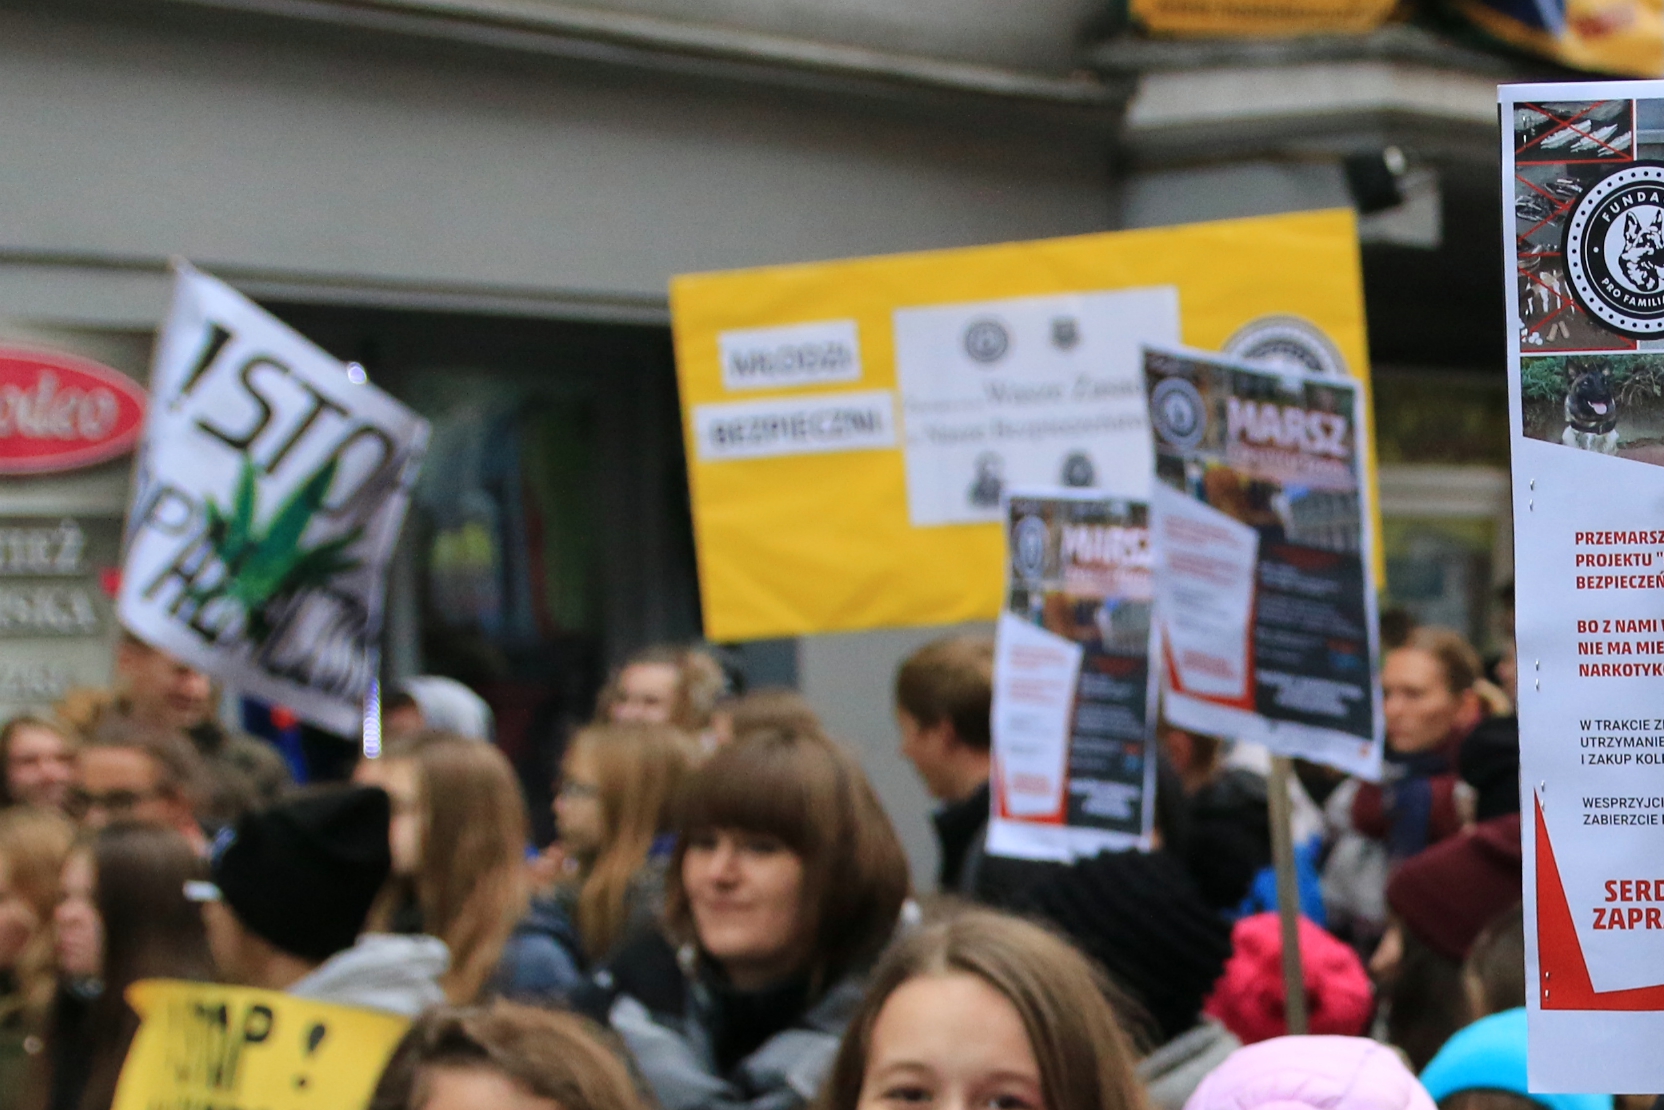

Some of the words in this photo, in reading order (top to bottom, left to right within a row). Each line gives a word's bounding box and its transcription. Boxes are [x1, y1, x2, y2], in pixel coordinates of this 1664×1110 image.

[1601, 277, 1621, 298] PRO
[1575, 553, 1652, 567] PROJEKTU
[1577, 619, 1599, 634] BO
[1602, 619, 1611, 633] Z
[1615, 619, 1657, 633] NAMI
[1578, 641, 1604, 655] NIE
[1607, 641, 1632, 655] MA
[1580, 719, 1592, 731] W
[1595, 719, 1651, 731] TRAKCIE
[1581, 754, 1585, 765] I
[1588, 753, 1632, 765] ZAKUP
[1583, 813, 1658, 826] ZABIERZCIE
